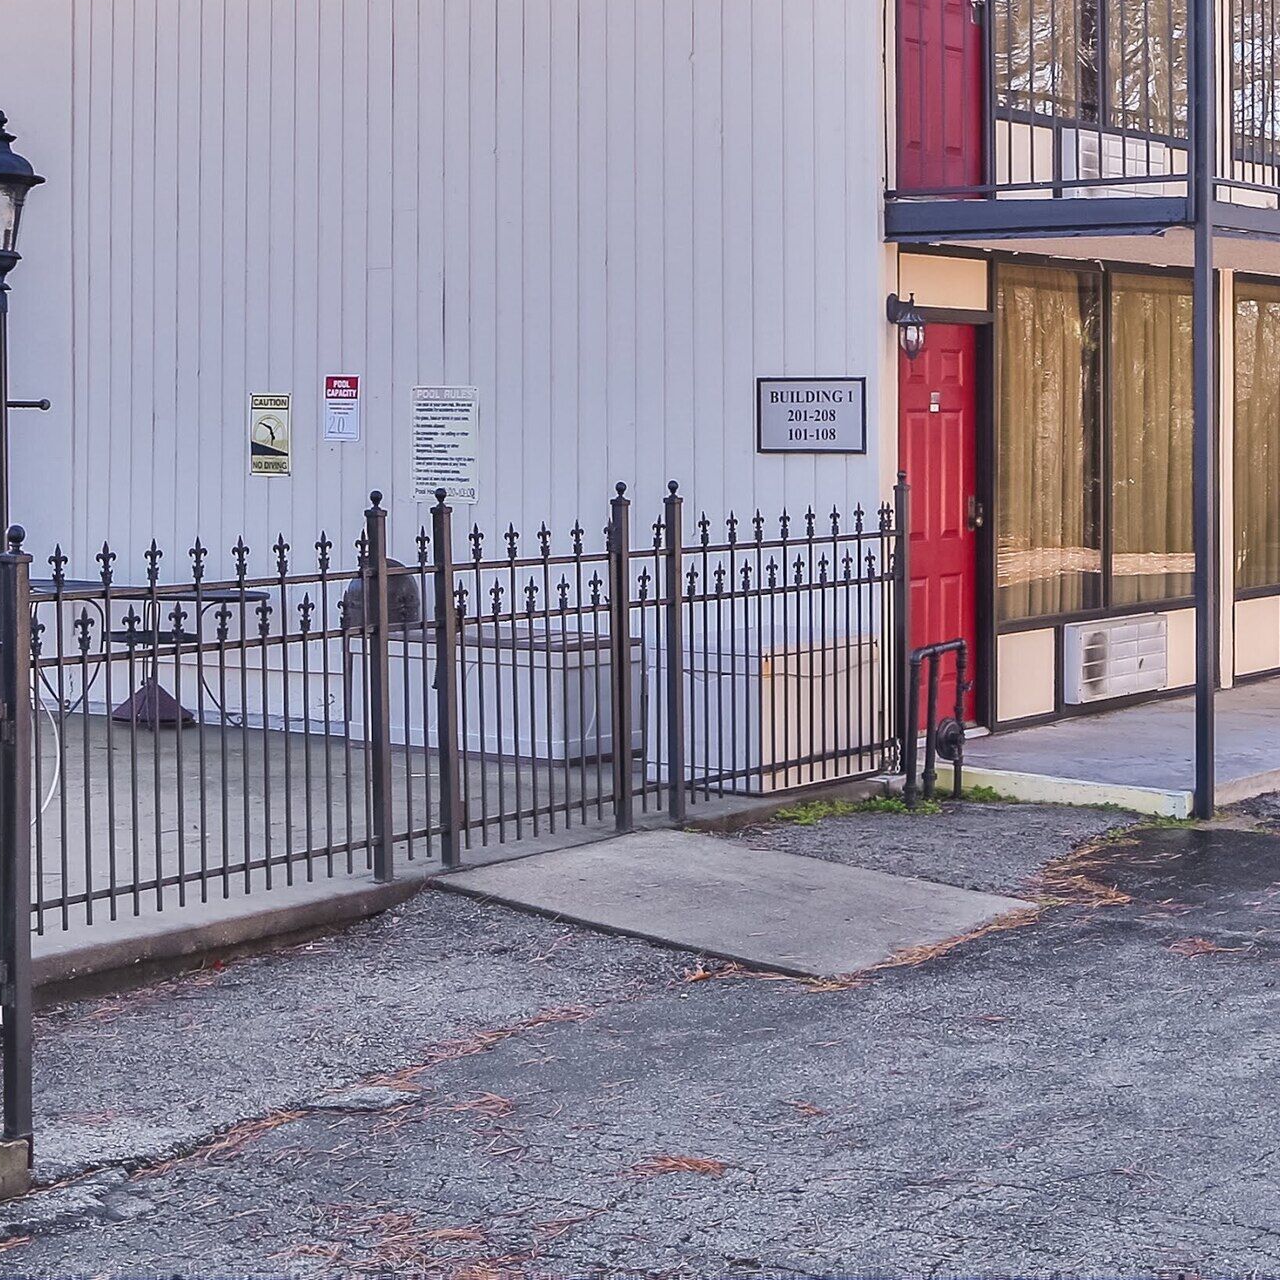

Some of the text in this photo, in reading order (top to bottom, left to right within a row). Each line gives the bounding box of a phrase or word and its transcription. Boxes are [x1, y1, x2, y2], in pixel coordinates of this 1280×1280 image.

[333, 380, 350, 388] POOL
[327, 389, 356, 397] CAPACITY
[416, 389, 472, 398] POOL RULES
[770, 390, 853, 403] BUILDING 1
[253, 398, 287, 406] CAUTION
[787, 409, 836, 421] 201-208
[328, 416, 345, 433] 20
[788, 428, 836, 440] 101-108
[252, 461, 287, 470] NO DIVING
